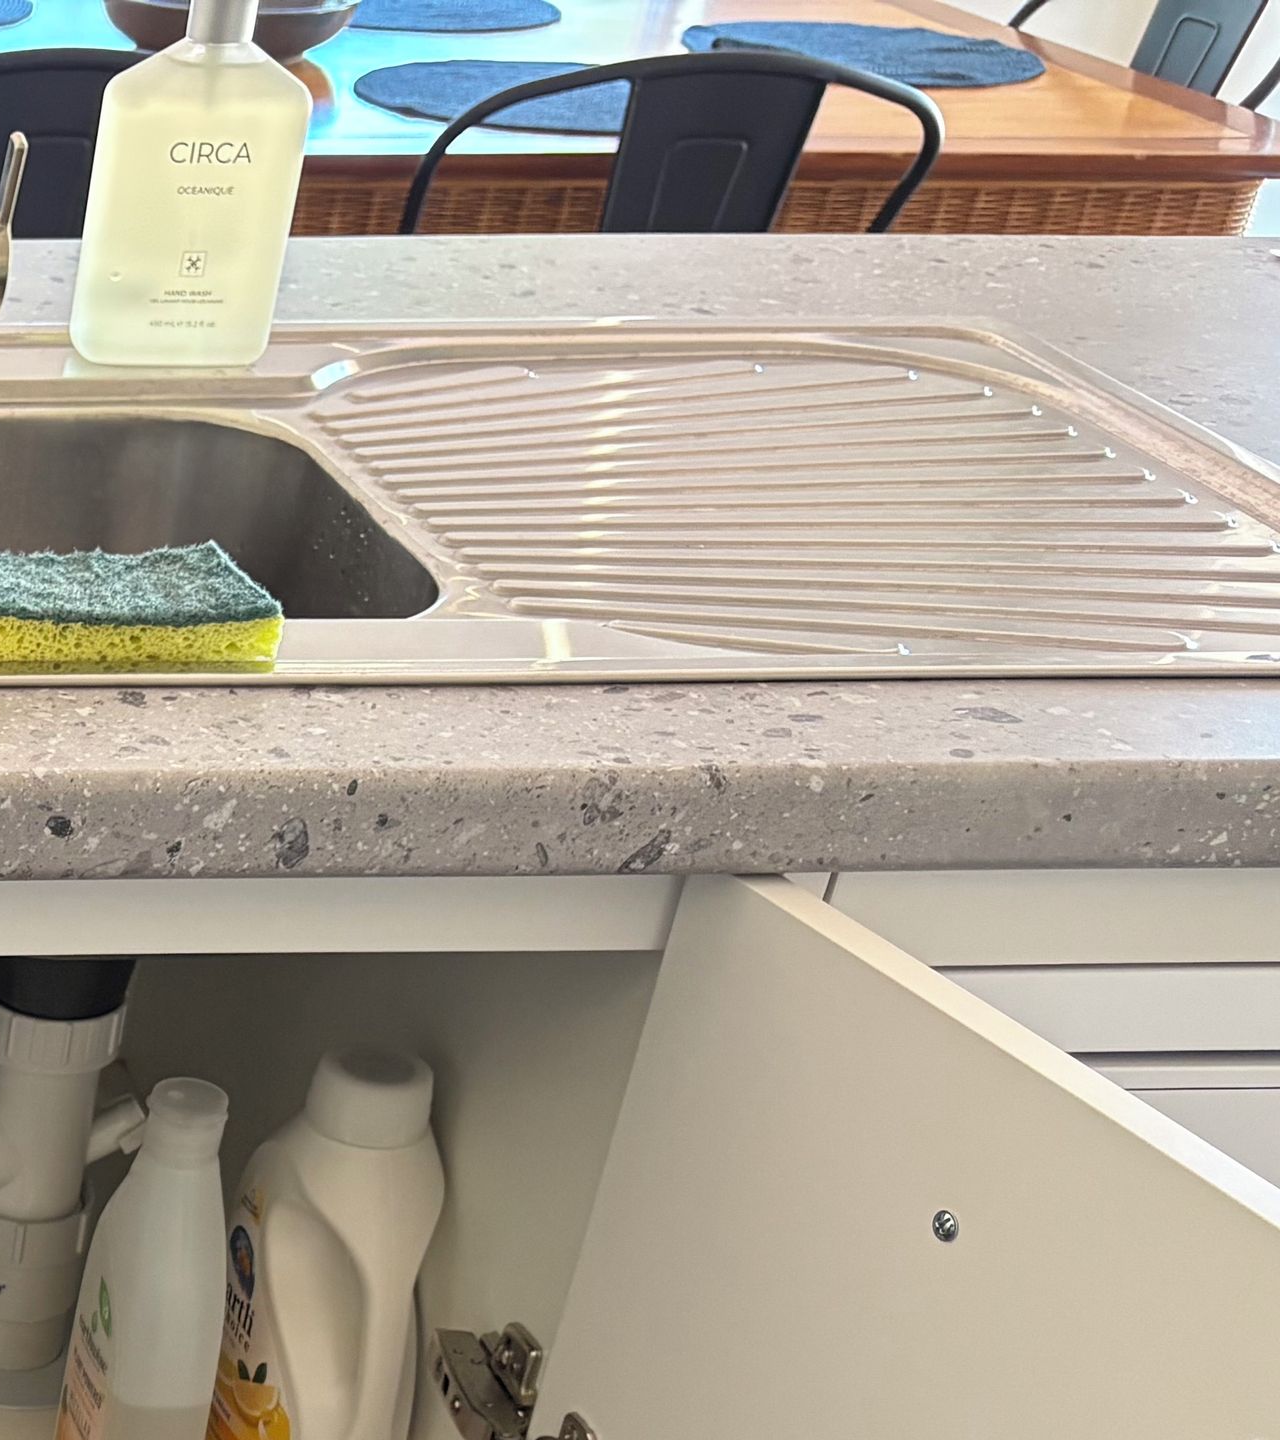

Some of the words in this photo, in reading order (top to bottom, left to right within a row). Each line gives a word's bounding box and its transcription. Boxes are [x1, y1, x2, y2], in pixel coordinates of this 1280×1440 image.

[169, 141, 251, 164] CIRCA
[176, 185, 235, 196] OCEANIQUE
[226, 1283, 255, 1338] arth
